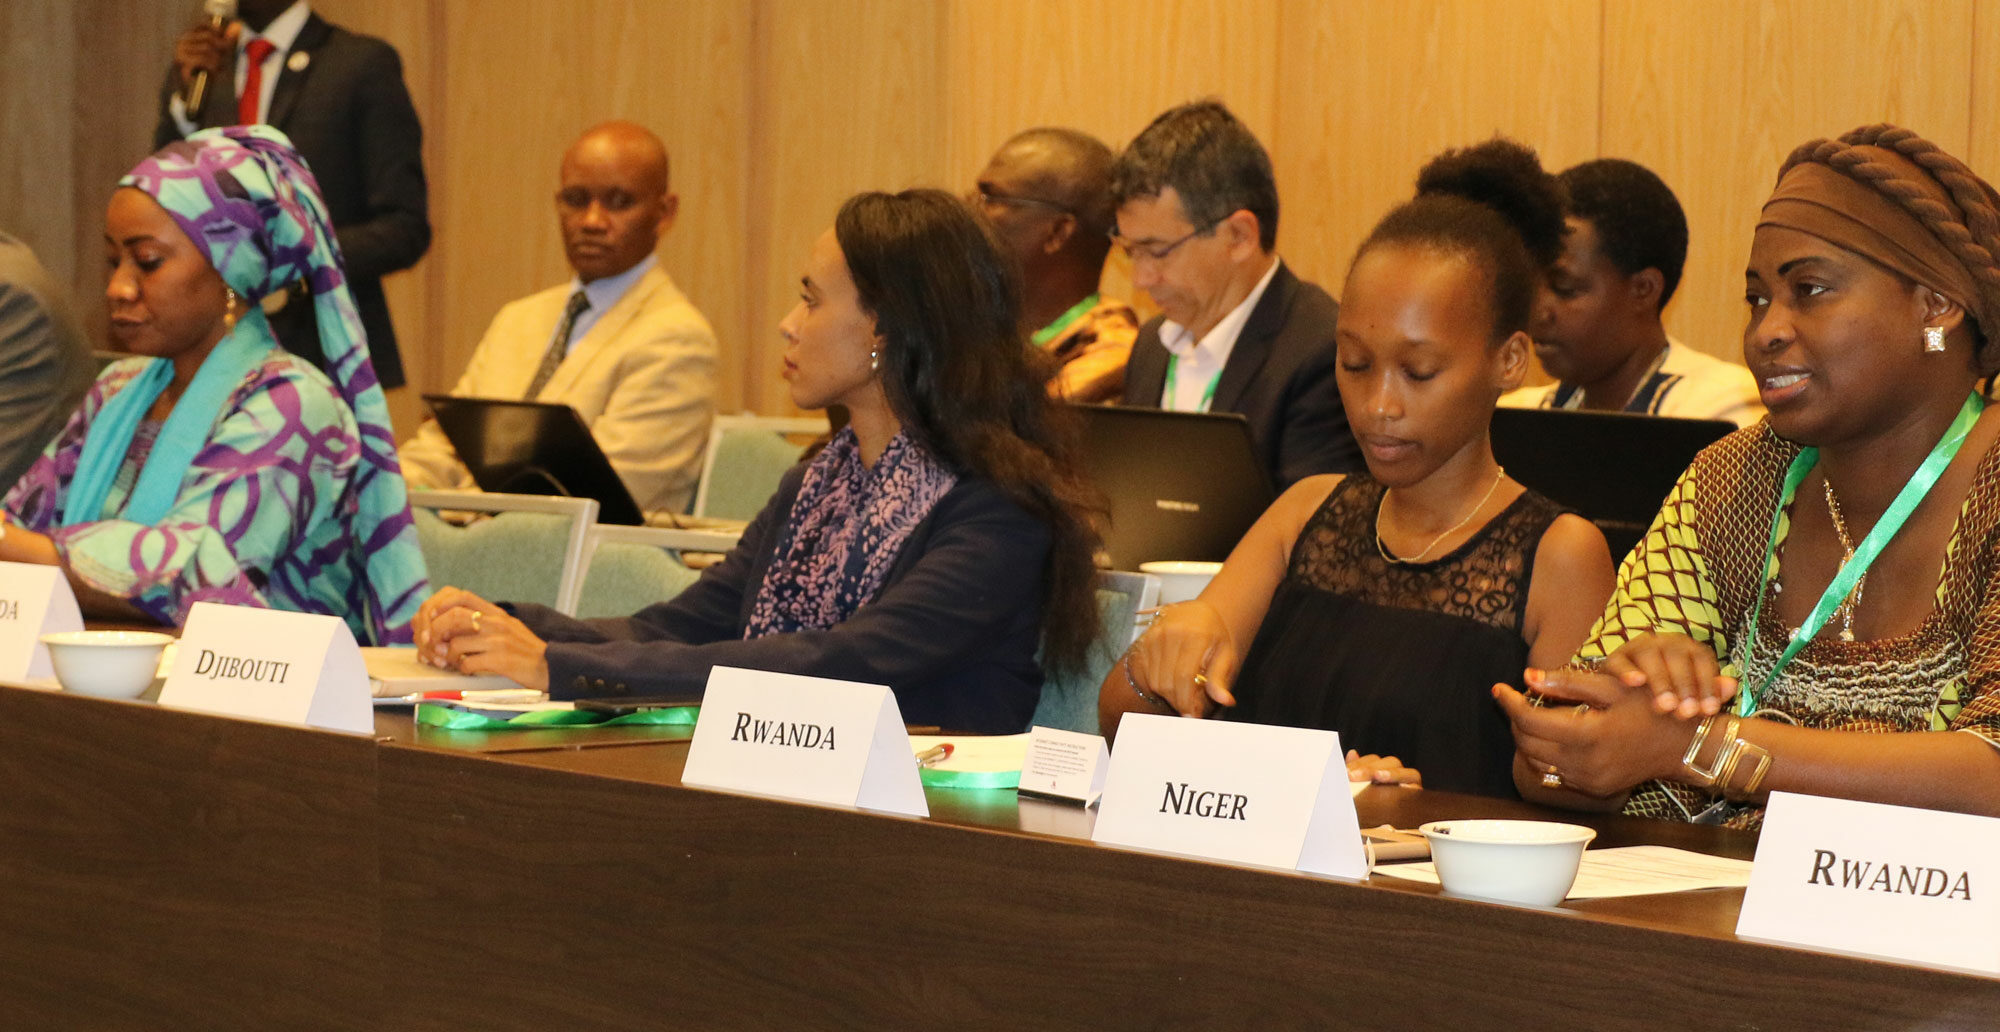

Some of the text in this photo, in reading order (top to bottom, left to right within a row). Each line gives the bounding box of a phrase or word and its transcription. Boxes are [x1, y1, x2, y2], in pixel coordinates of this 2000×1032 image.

[194, 649, 290, 684] DJIBOUTI
[730, 711, 836, 751] RWANDA
[1158, 781, 1248, 821] NIGER
[1806, 848, 1972, 901] RWANDA
